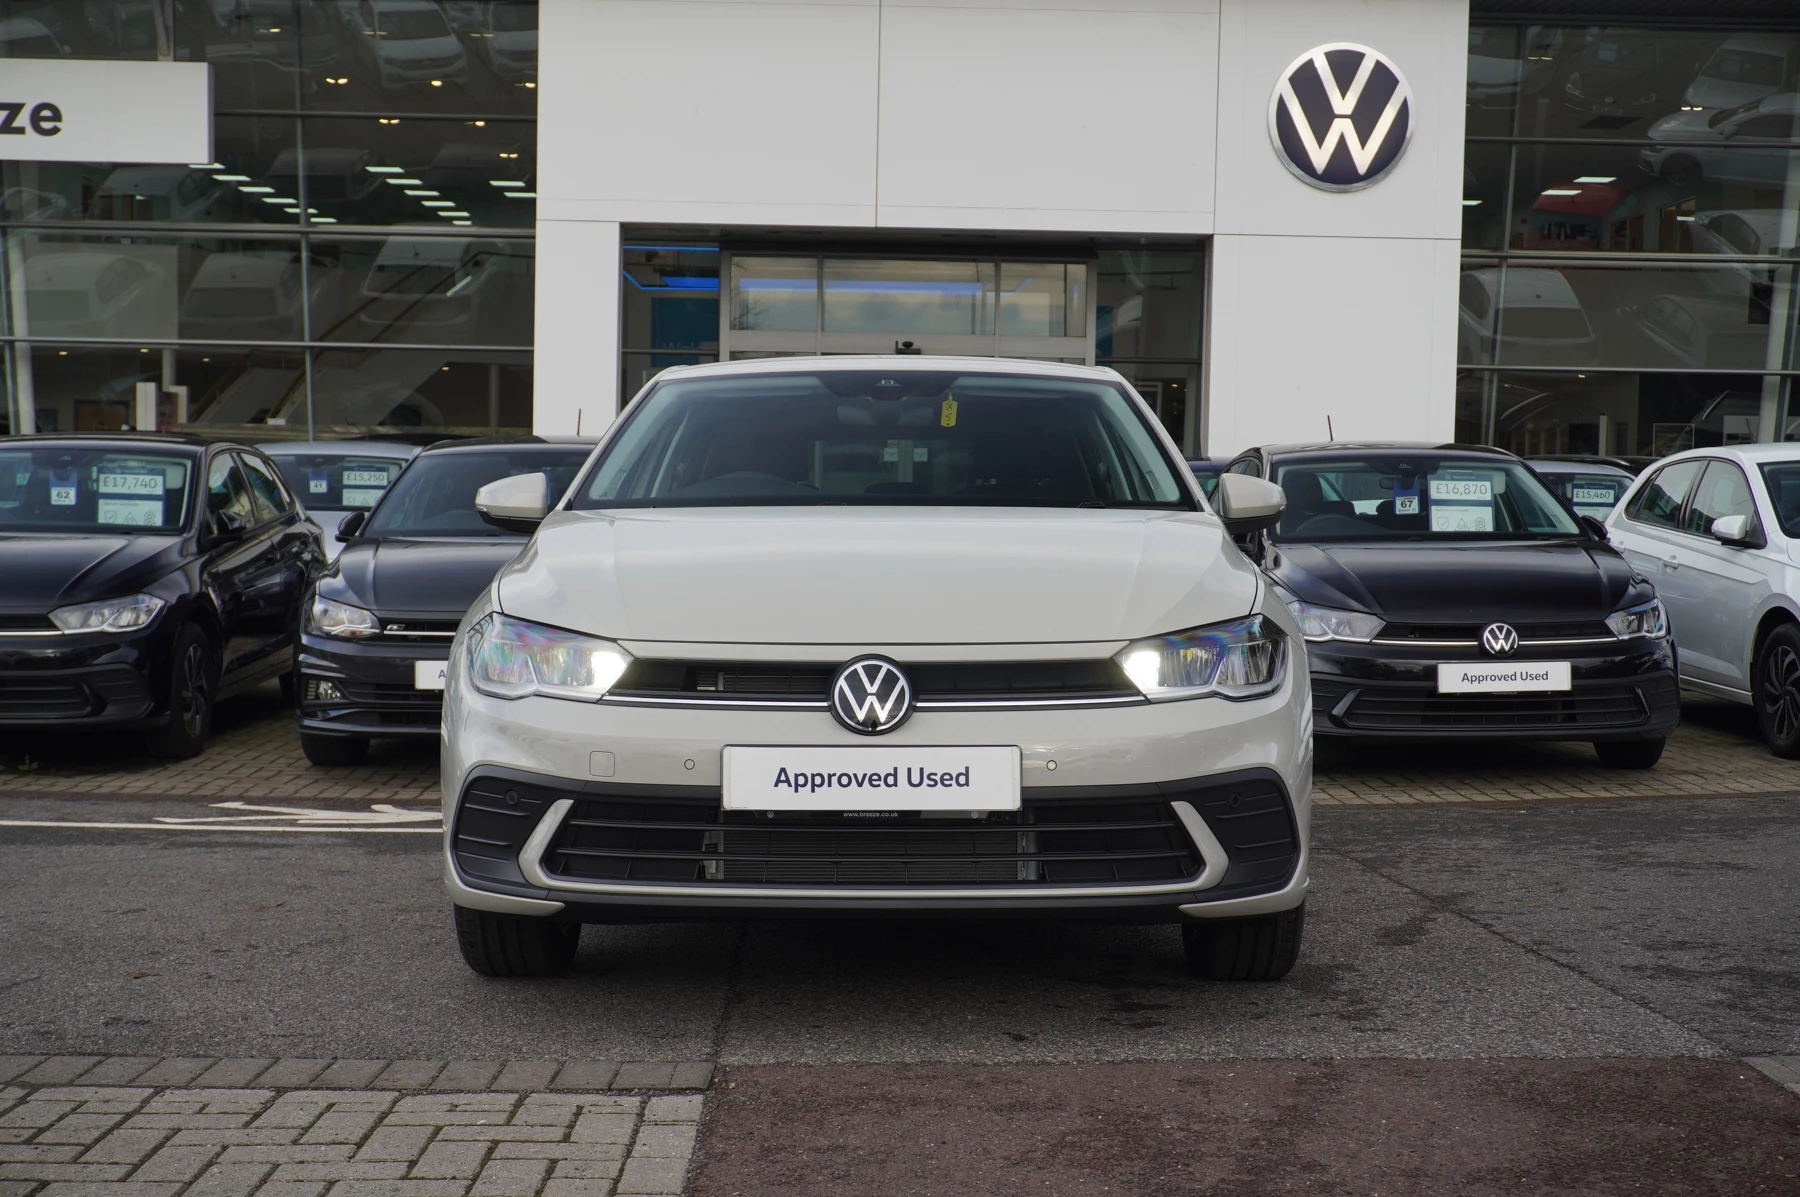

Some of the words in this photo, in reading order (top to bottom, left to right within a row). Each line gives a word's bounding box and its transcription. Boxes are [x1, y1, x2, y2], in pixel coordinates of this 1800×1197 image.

[102, 476, 158, 489] £17,740
[346, 472, 385, 482] £15,250
[56, 490, 70, 499] 62
[1435, 483, 1488, 496] £16,870
[1575, 490, 1611, 499] £15,460
[1400, 500, 1414, 509] 67
[1461, 671, 1517, 685] Approved
[1520, 670, 1549, 681] Used
[773, 766, 898, 793] Approved
[906, 766, 970, 787] Used
